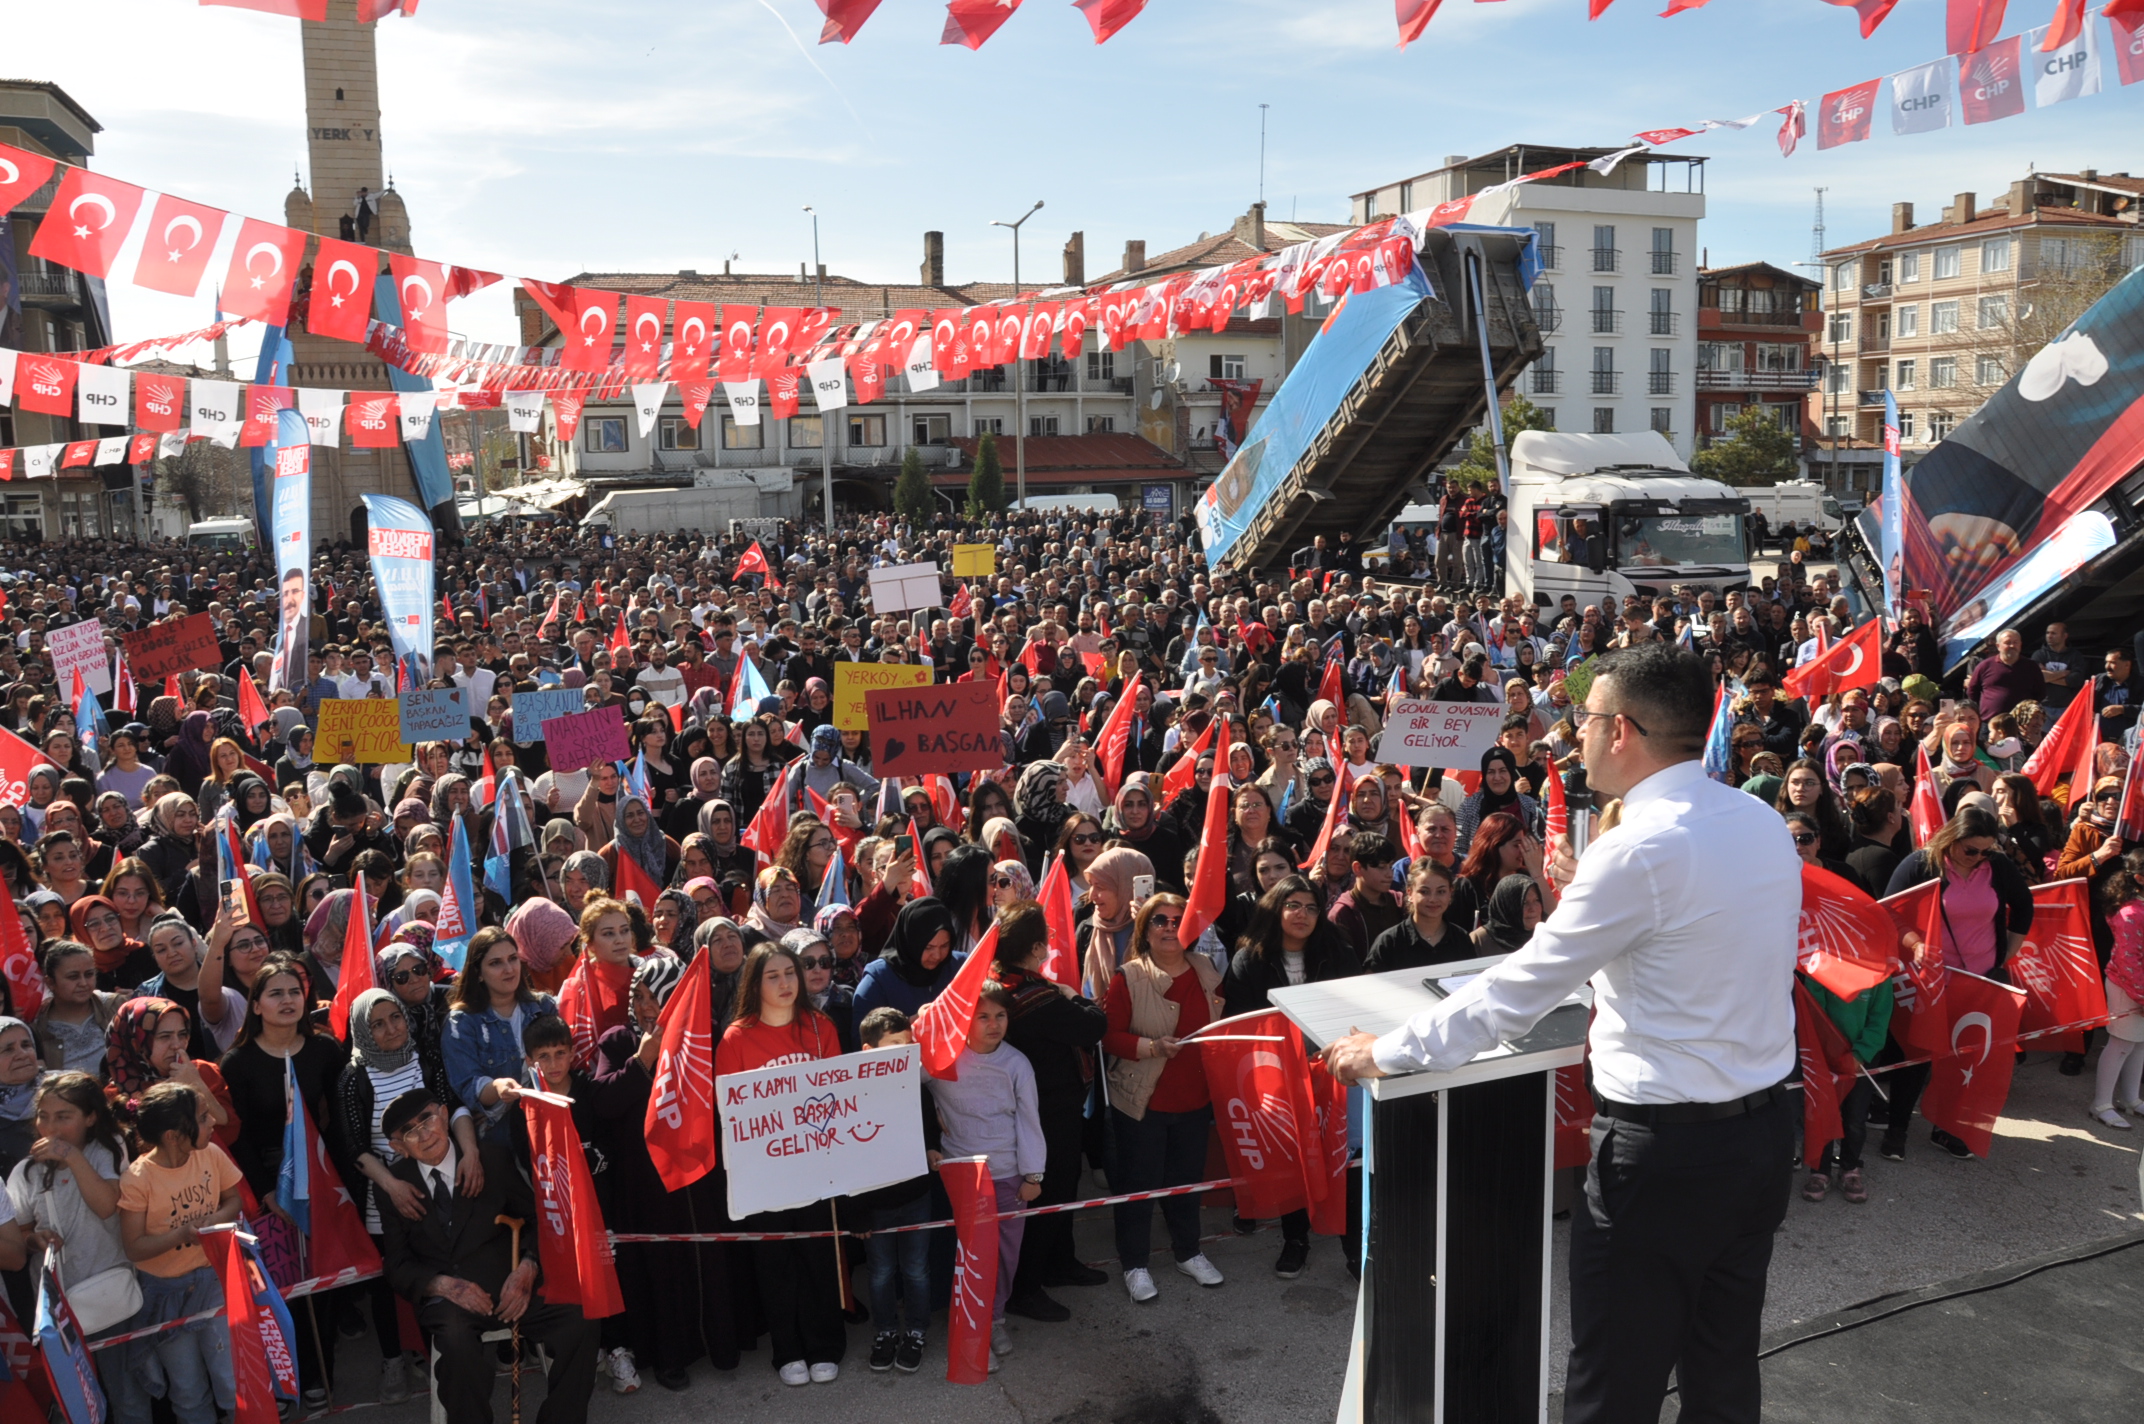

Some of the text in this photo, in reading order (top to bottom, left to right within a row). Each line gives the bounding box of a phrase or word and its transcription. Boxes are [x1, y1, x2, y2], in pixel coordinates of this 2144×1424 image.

[2043, 51, 2088, 76] CHP
[1974, 79, 2010, 101] CHP
[1900, 93, 1941, 113] CHP
[1831, 107, 1864, 125] CHP
[1439, 204, 1465, 214] CHP
[1210, 506, 1222, 538] CHP
[83, 633, 103, 645] VAR
[126, 629, 152, 645] HER
[138, 652, 197, 680] OLACAK
[845, 669, 899, 686] YERKÖY
[407, 691, 434, 707] SENİ
[406, 705, 447, 719] BAŞKAN
[406, 714, 464, 732] YAPACAĞIZ
[876, 699, 957, 724] İLHAN
[1447, 705, 1501, 718] OVASINA
[1409, 716, 1471, 733] BİR BEY
[556, 743, 615, 771] BAHAR
[3, 779, 28, 806] CH
[3, 953, 45, 989] CH
[656, 1049, 683, 1130] CHP
[726, 1085, 749, 1106] AÇ
[753, 1075, 798, 1100] KAPIYI
[857, 1050, 910, 1080] EFENDİ
[729, 1095, 859, 1143] İLHAN BAŞKAN
[1228, 1098, 1265, 1170] CHP
[537, 1154, 565, 1236] CHP
